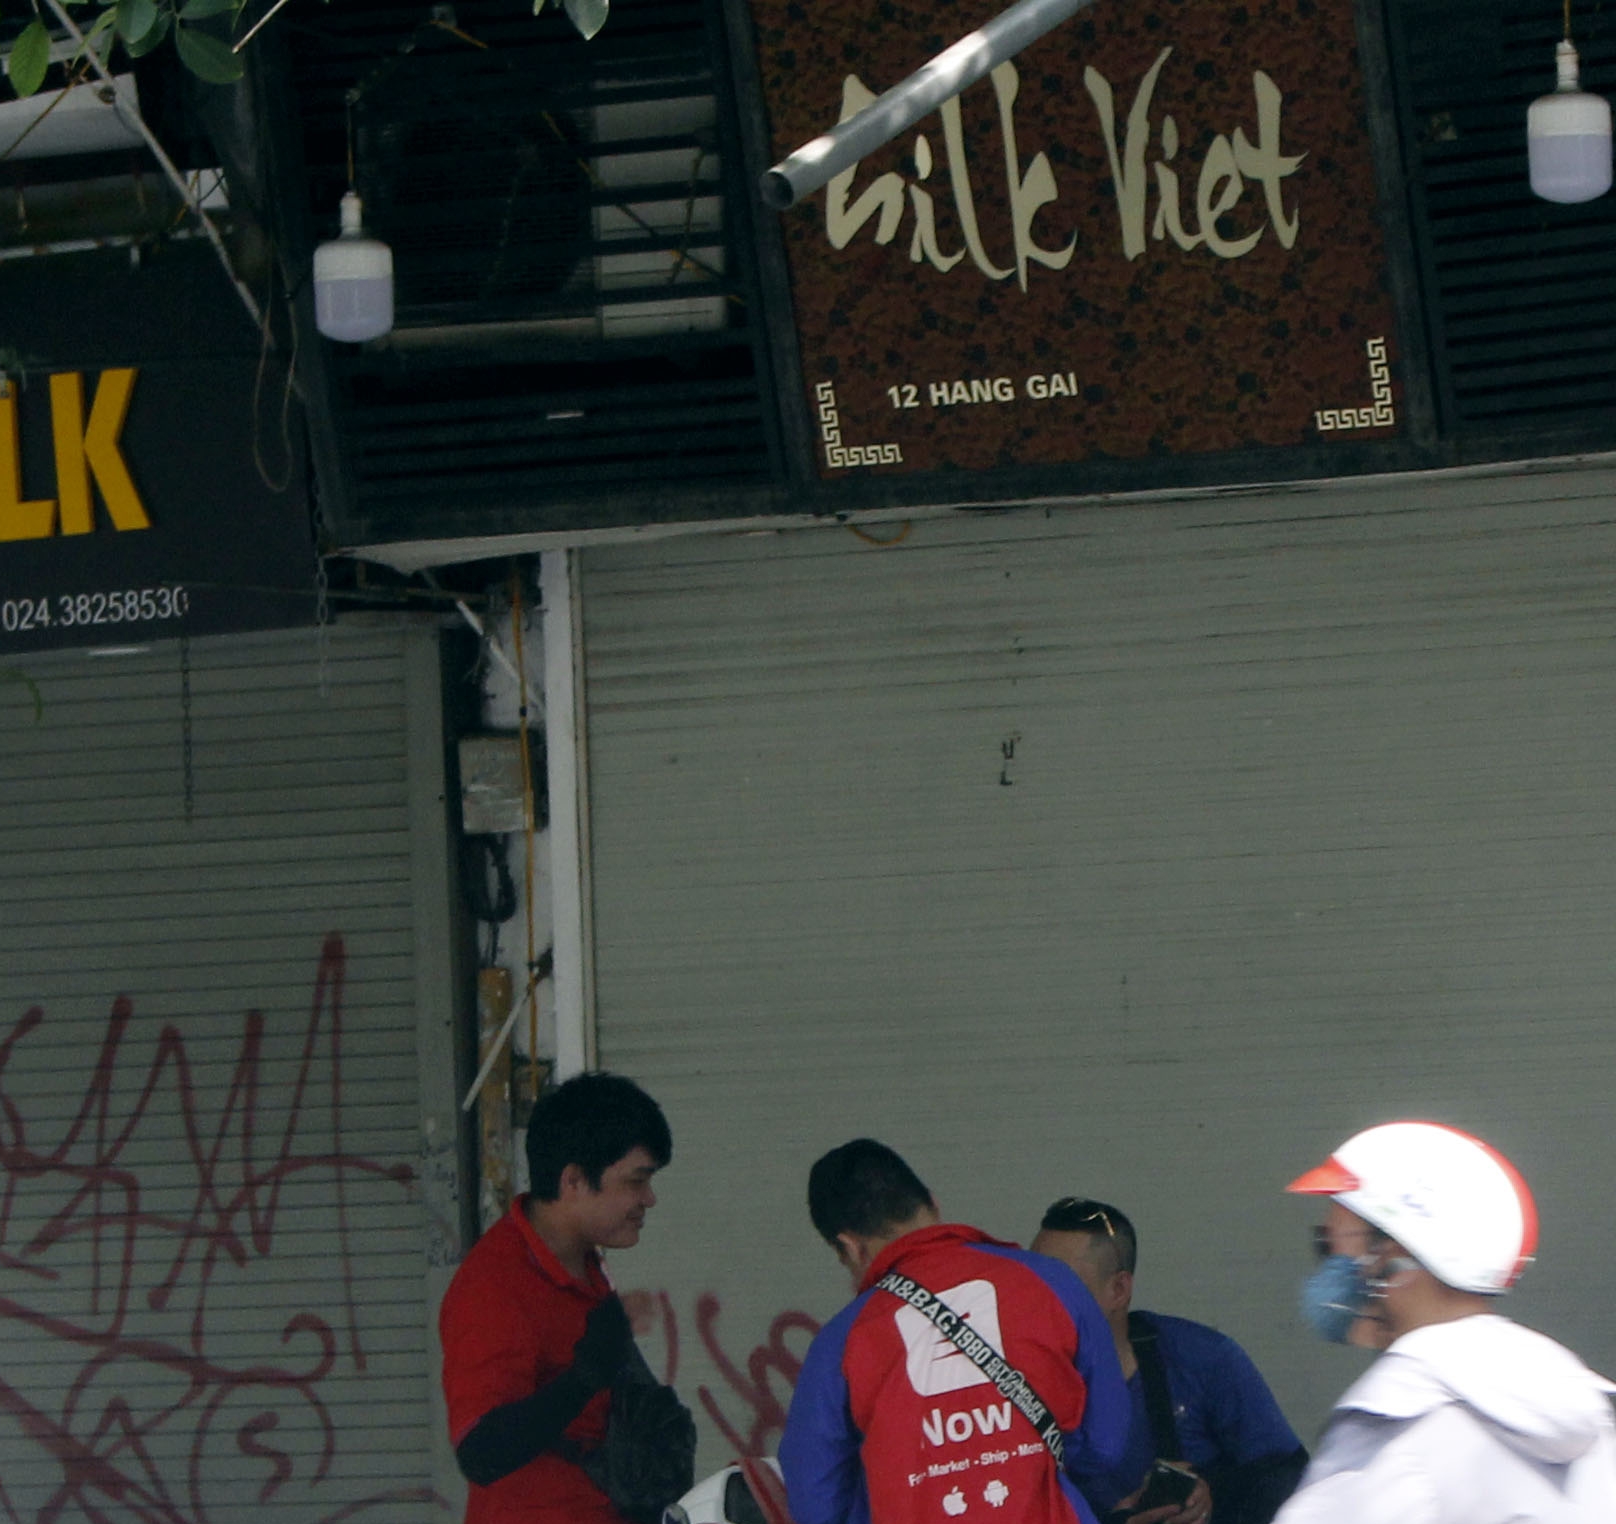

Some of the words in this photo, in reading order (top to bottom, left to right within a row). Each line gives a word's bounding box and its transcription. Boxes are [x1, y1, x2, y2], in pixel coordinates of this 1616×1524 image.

[1084, 46, 1310, 262] Viet
[887, 384, 919, 410] 12
[929, 377, 1015, 407] HANG
[1026, 371, 1078, 401] GAI
